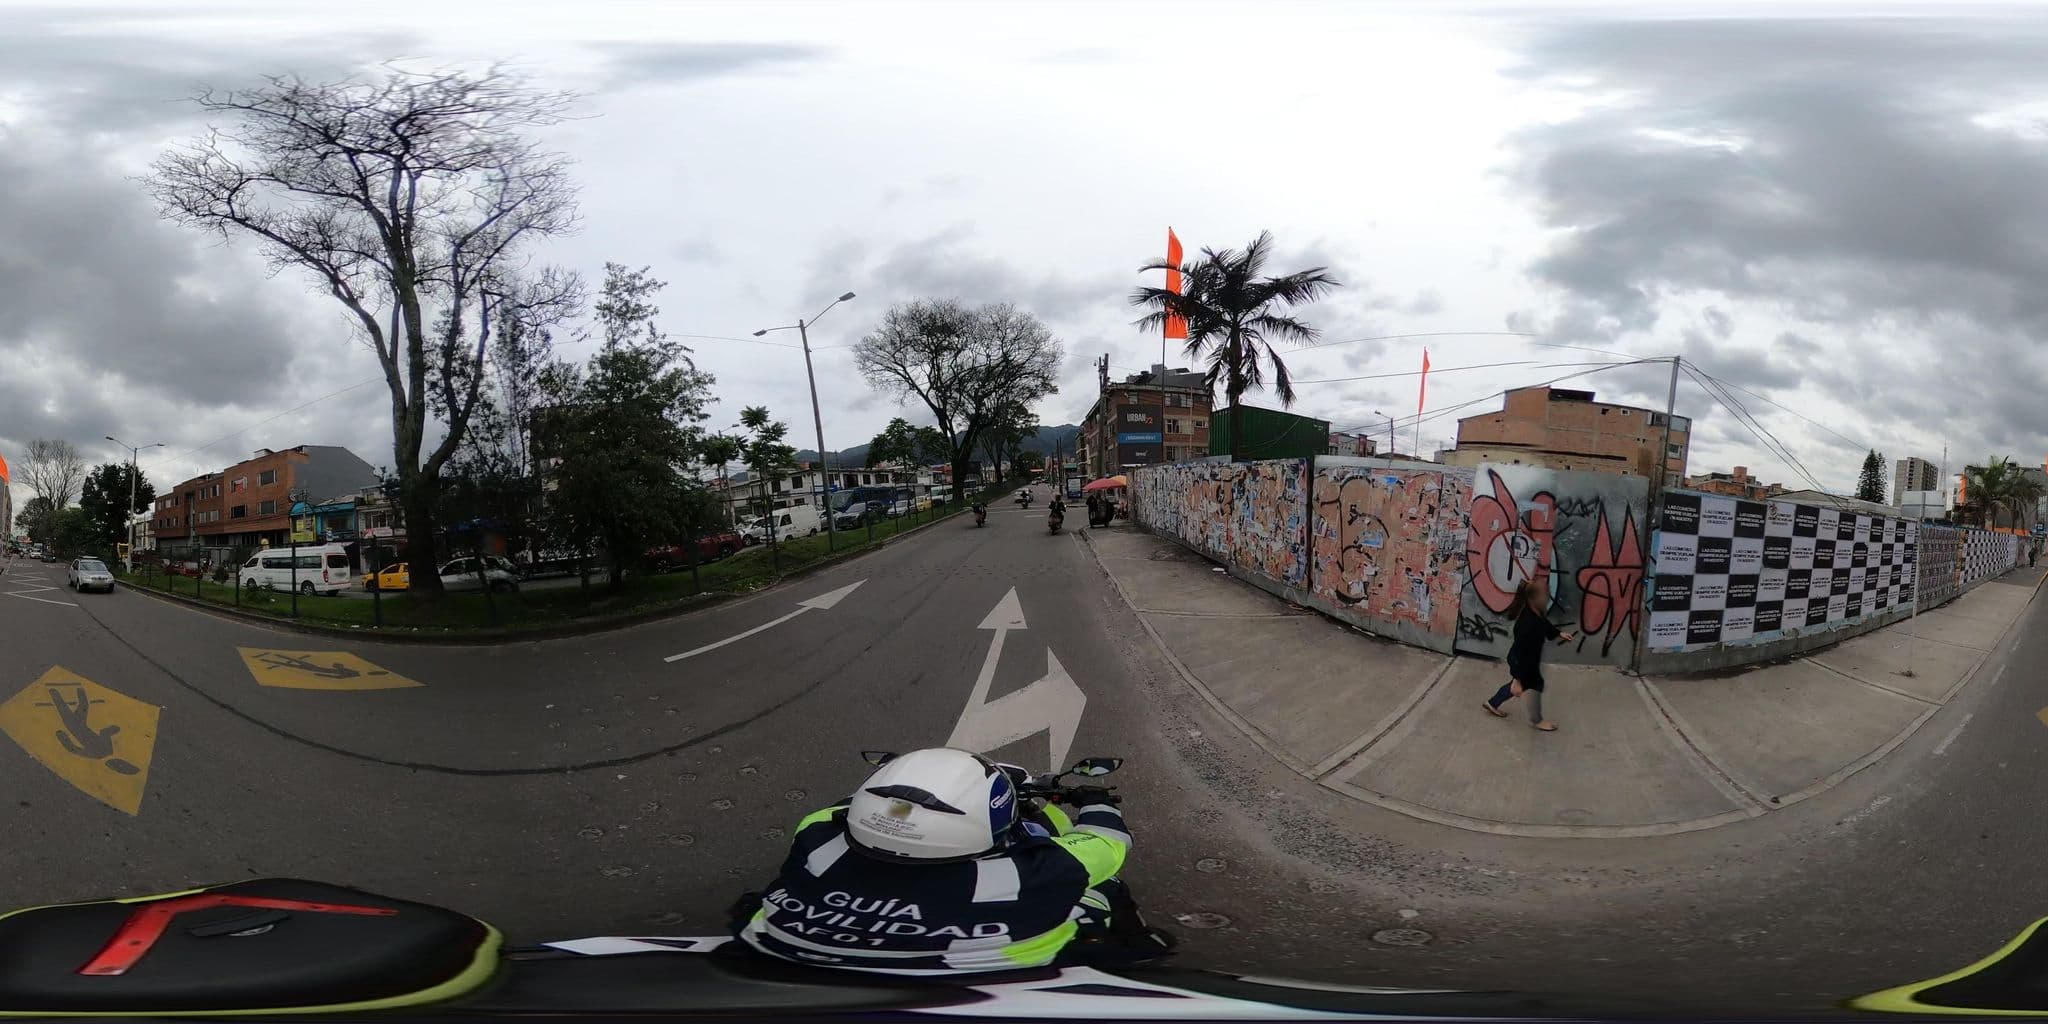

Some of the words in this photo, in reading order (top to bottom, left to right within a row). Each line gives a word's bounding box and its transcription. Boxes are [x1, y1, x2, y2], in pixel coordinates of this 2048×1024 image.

[1126, 413, 1146, 422] URBAN
[768, 888, 1010, 938] MOVILIDAD
[822, 891, 922, 920] GUÍA
